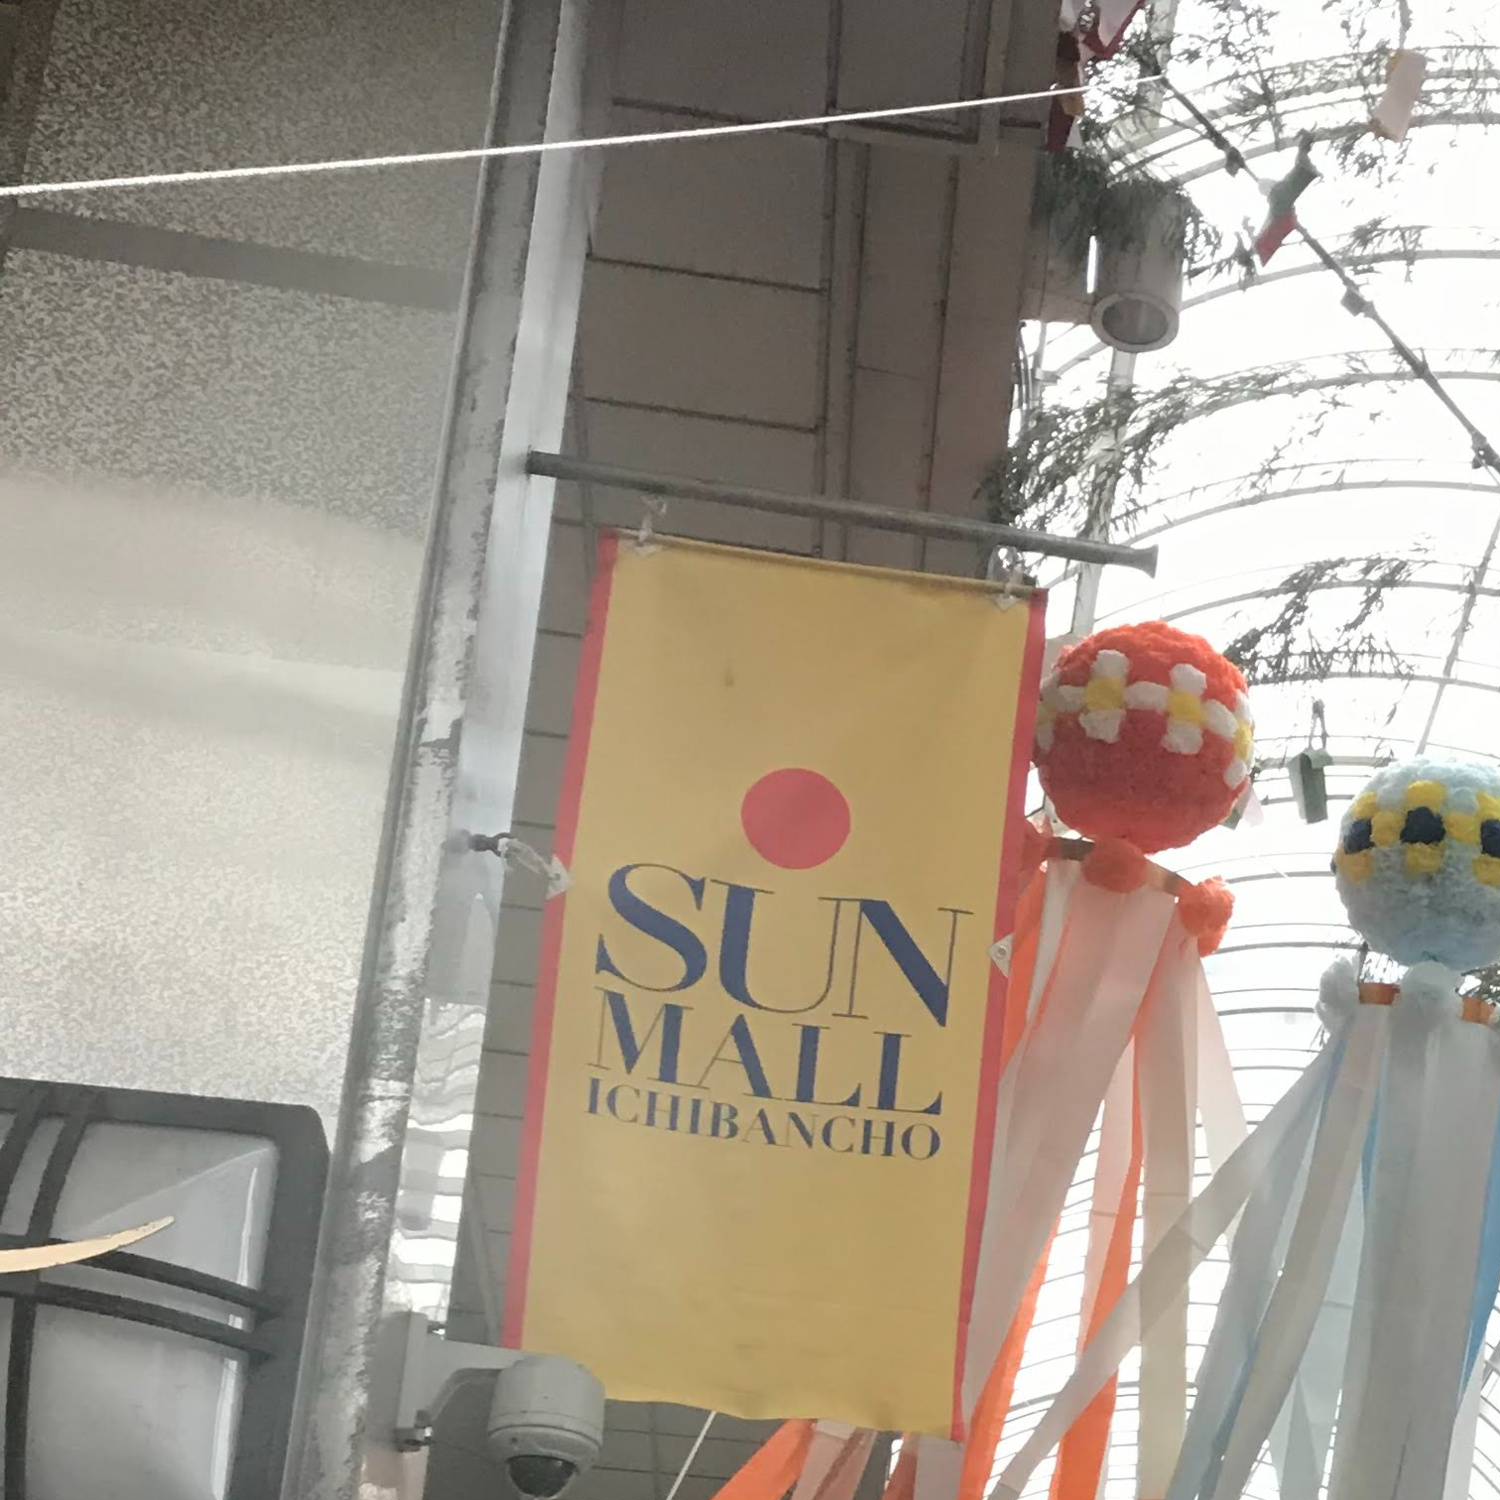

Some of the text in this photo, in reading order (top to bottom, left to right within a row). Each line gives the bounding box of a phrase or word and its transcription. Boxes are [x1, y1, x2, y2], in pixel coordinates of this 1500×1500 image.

[595, 863, 974, 1027] SUN
[587, 986, 943, 1115] MALL
[584, 1077, 941, 1161] ICHIBANCHO
